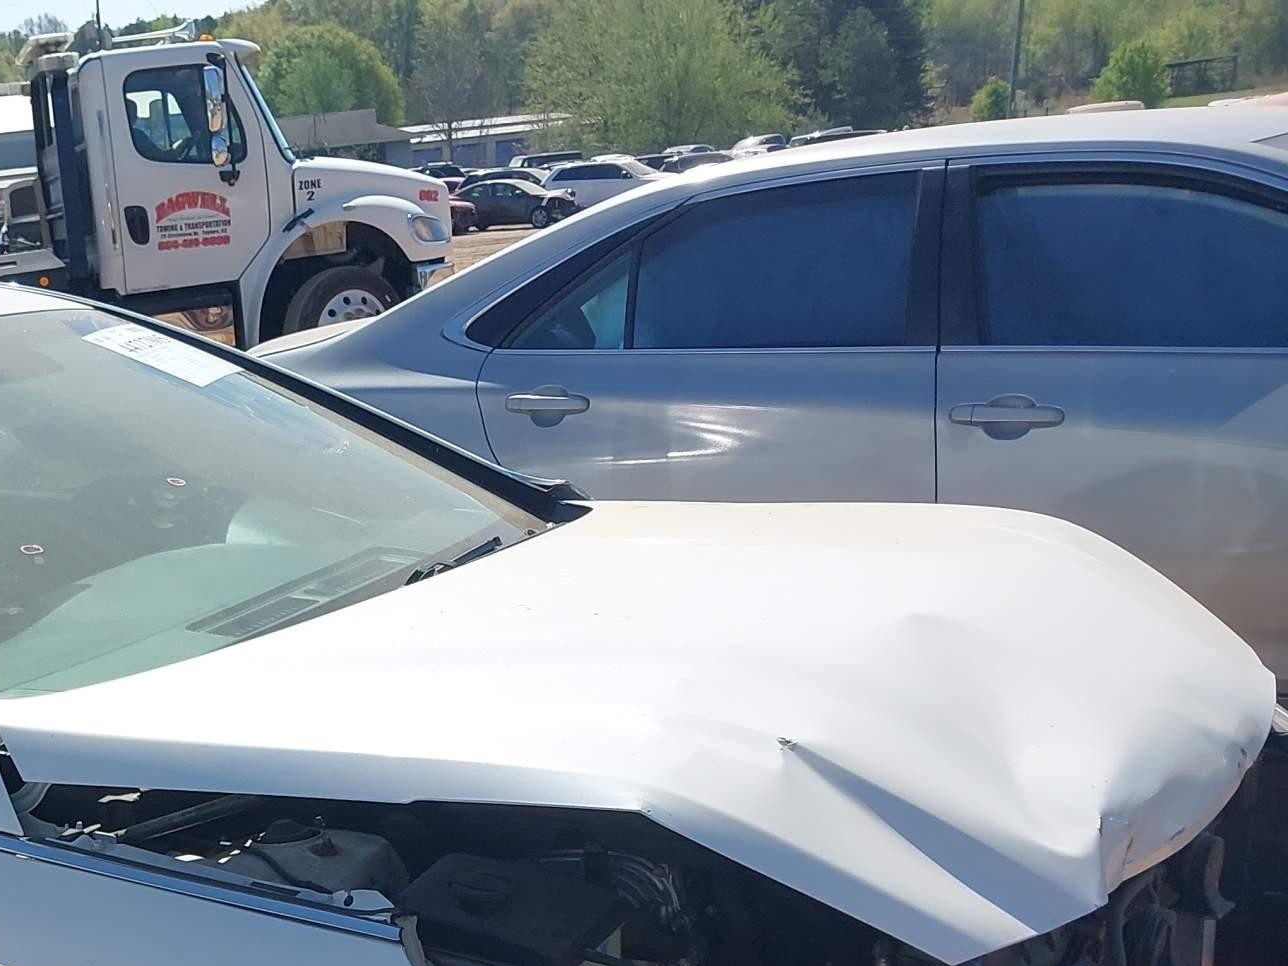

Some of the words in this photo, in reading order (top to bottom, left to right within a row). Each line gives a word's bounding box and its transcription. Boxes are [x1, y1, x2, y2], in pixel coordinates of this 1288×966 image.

[298, 178, 322, 190] ZONE
[306, 190, 315, 201] 2
[156, 223, 178, 232] TOWING
[184, 219, 231, 231] TRANSPORTATION
